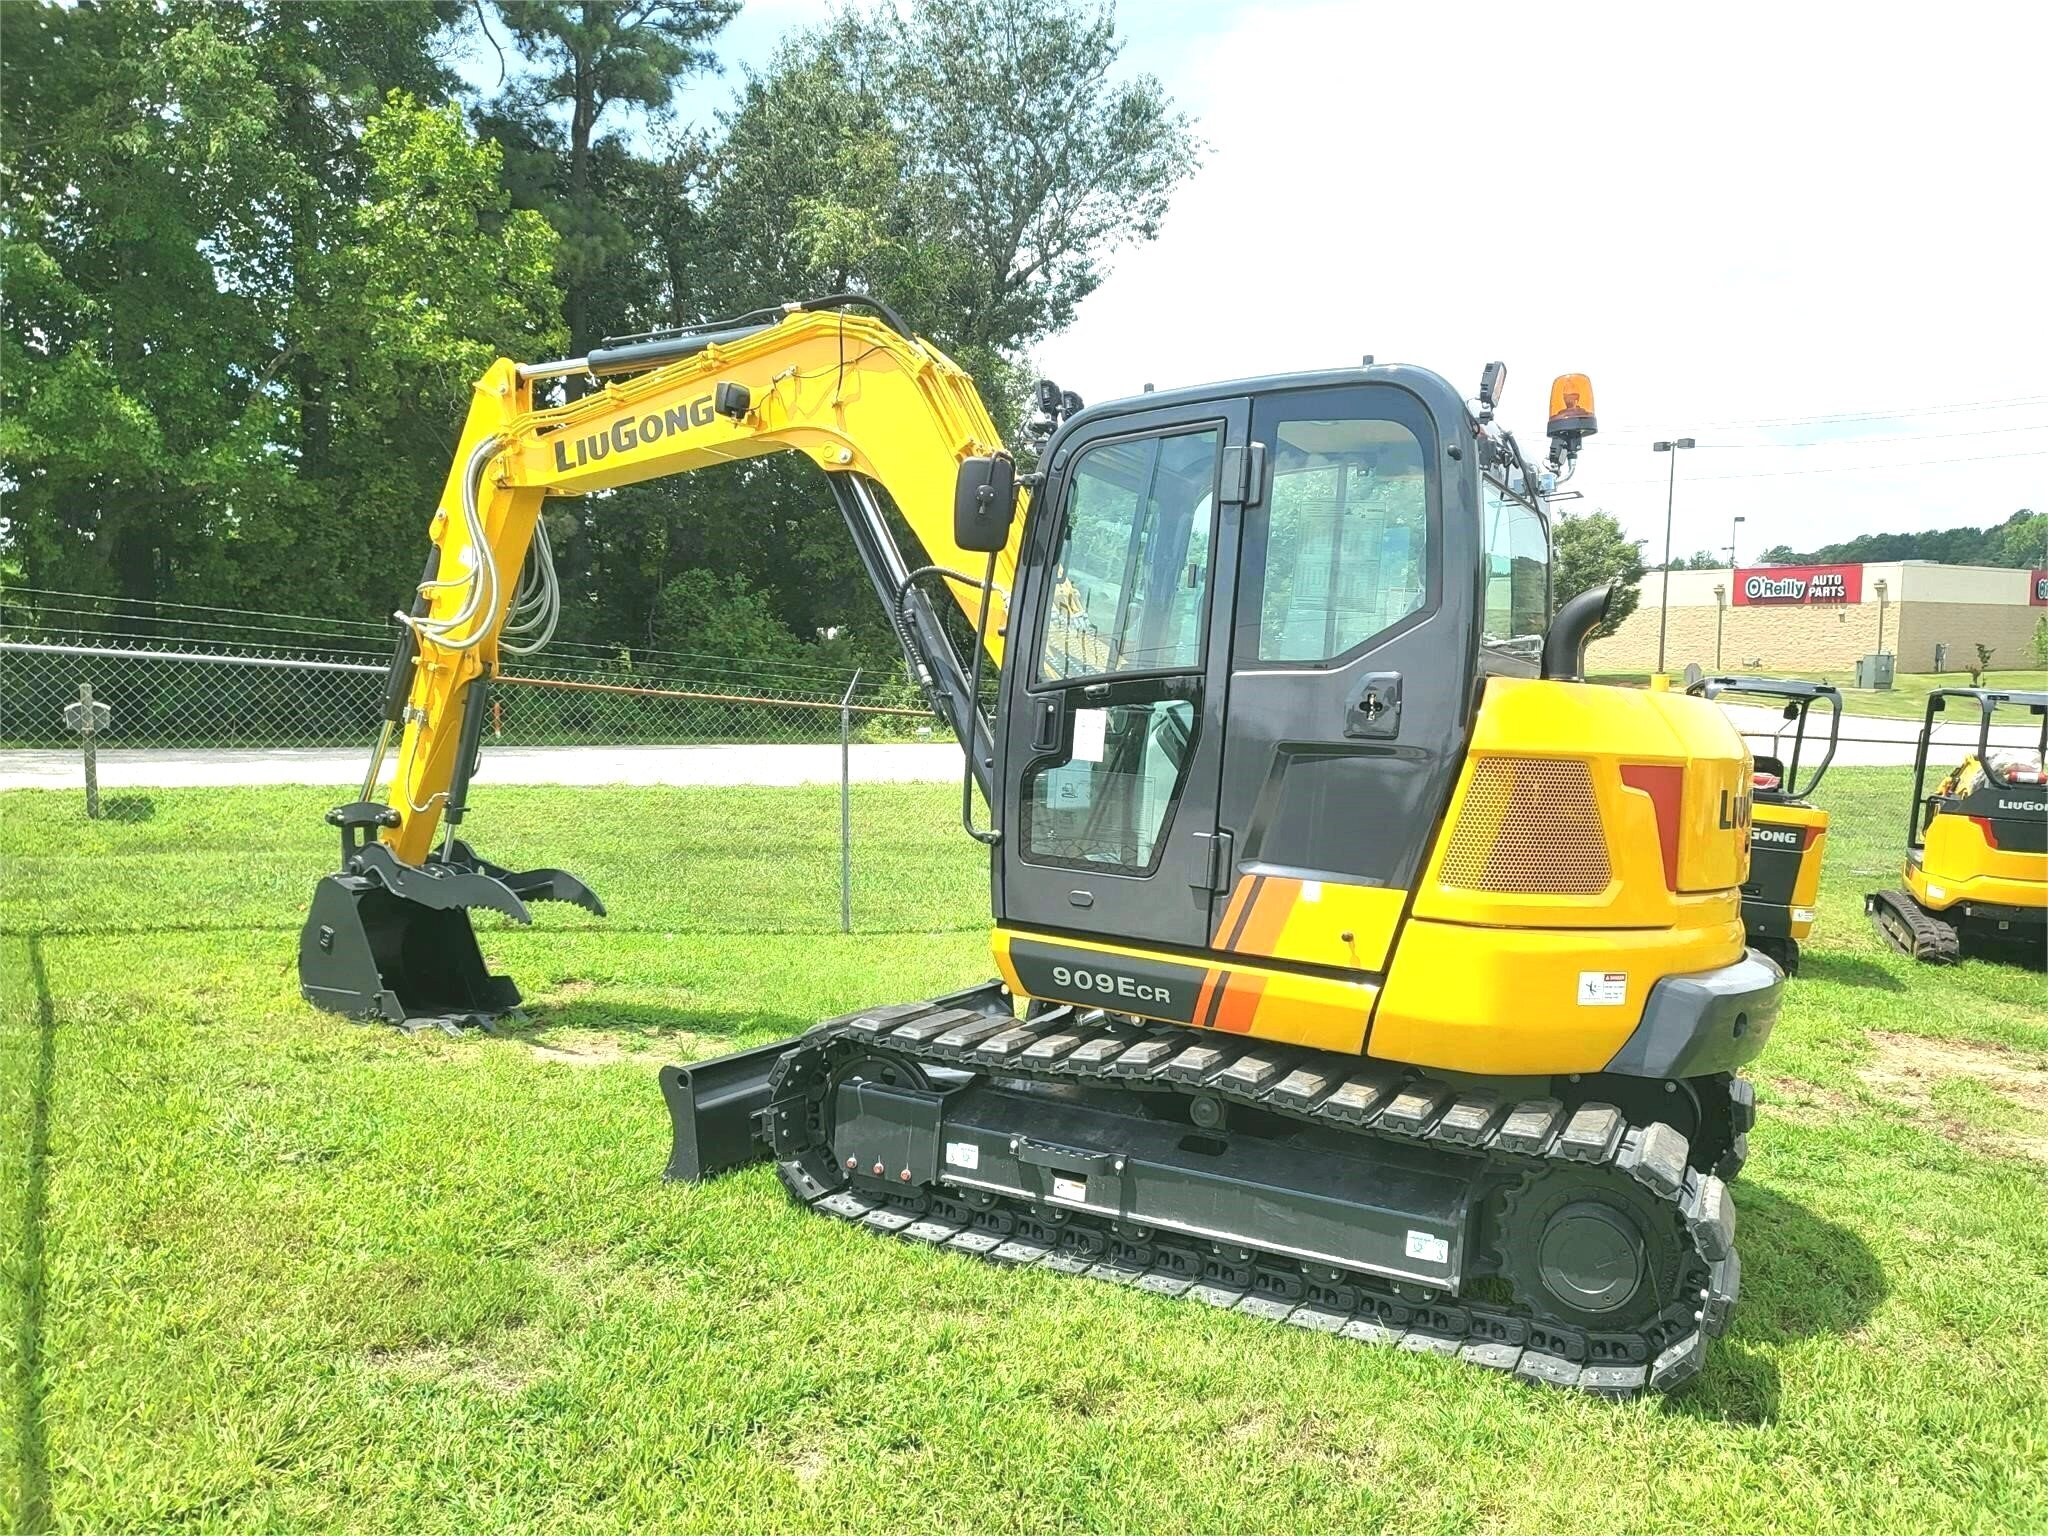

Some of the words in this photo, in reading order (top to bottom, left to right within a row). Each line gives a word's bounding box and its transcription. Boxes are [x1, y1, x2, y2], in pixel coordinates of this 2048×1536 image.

[1746, 576, 1806, 598] O'Reilly
[1811, 574, 1842, 586] AUTO
[1808, 586, 1845, 597] PARTS
[1719, 789, 1753, 830] LIU
[1752, 827, 1797, 844] GONG
